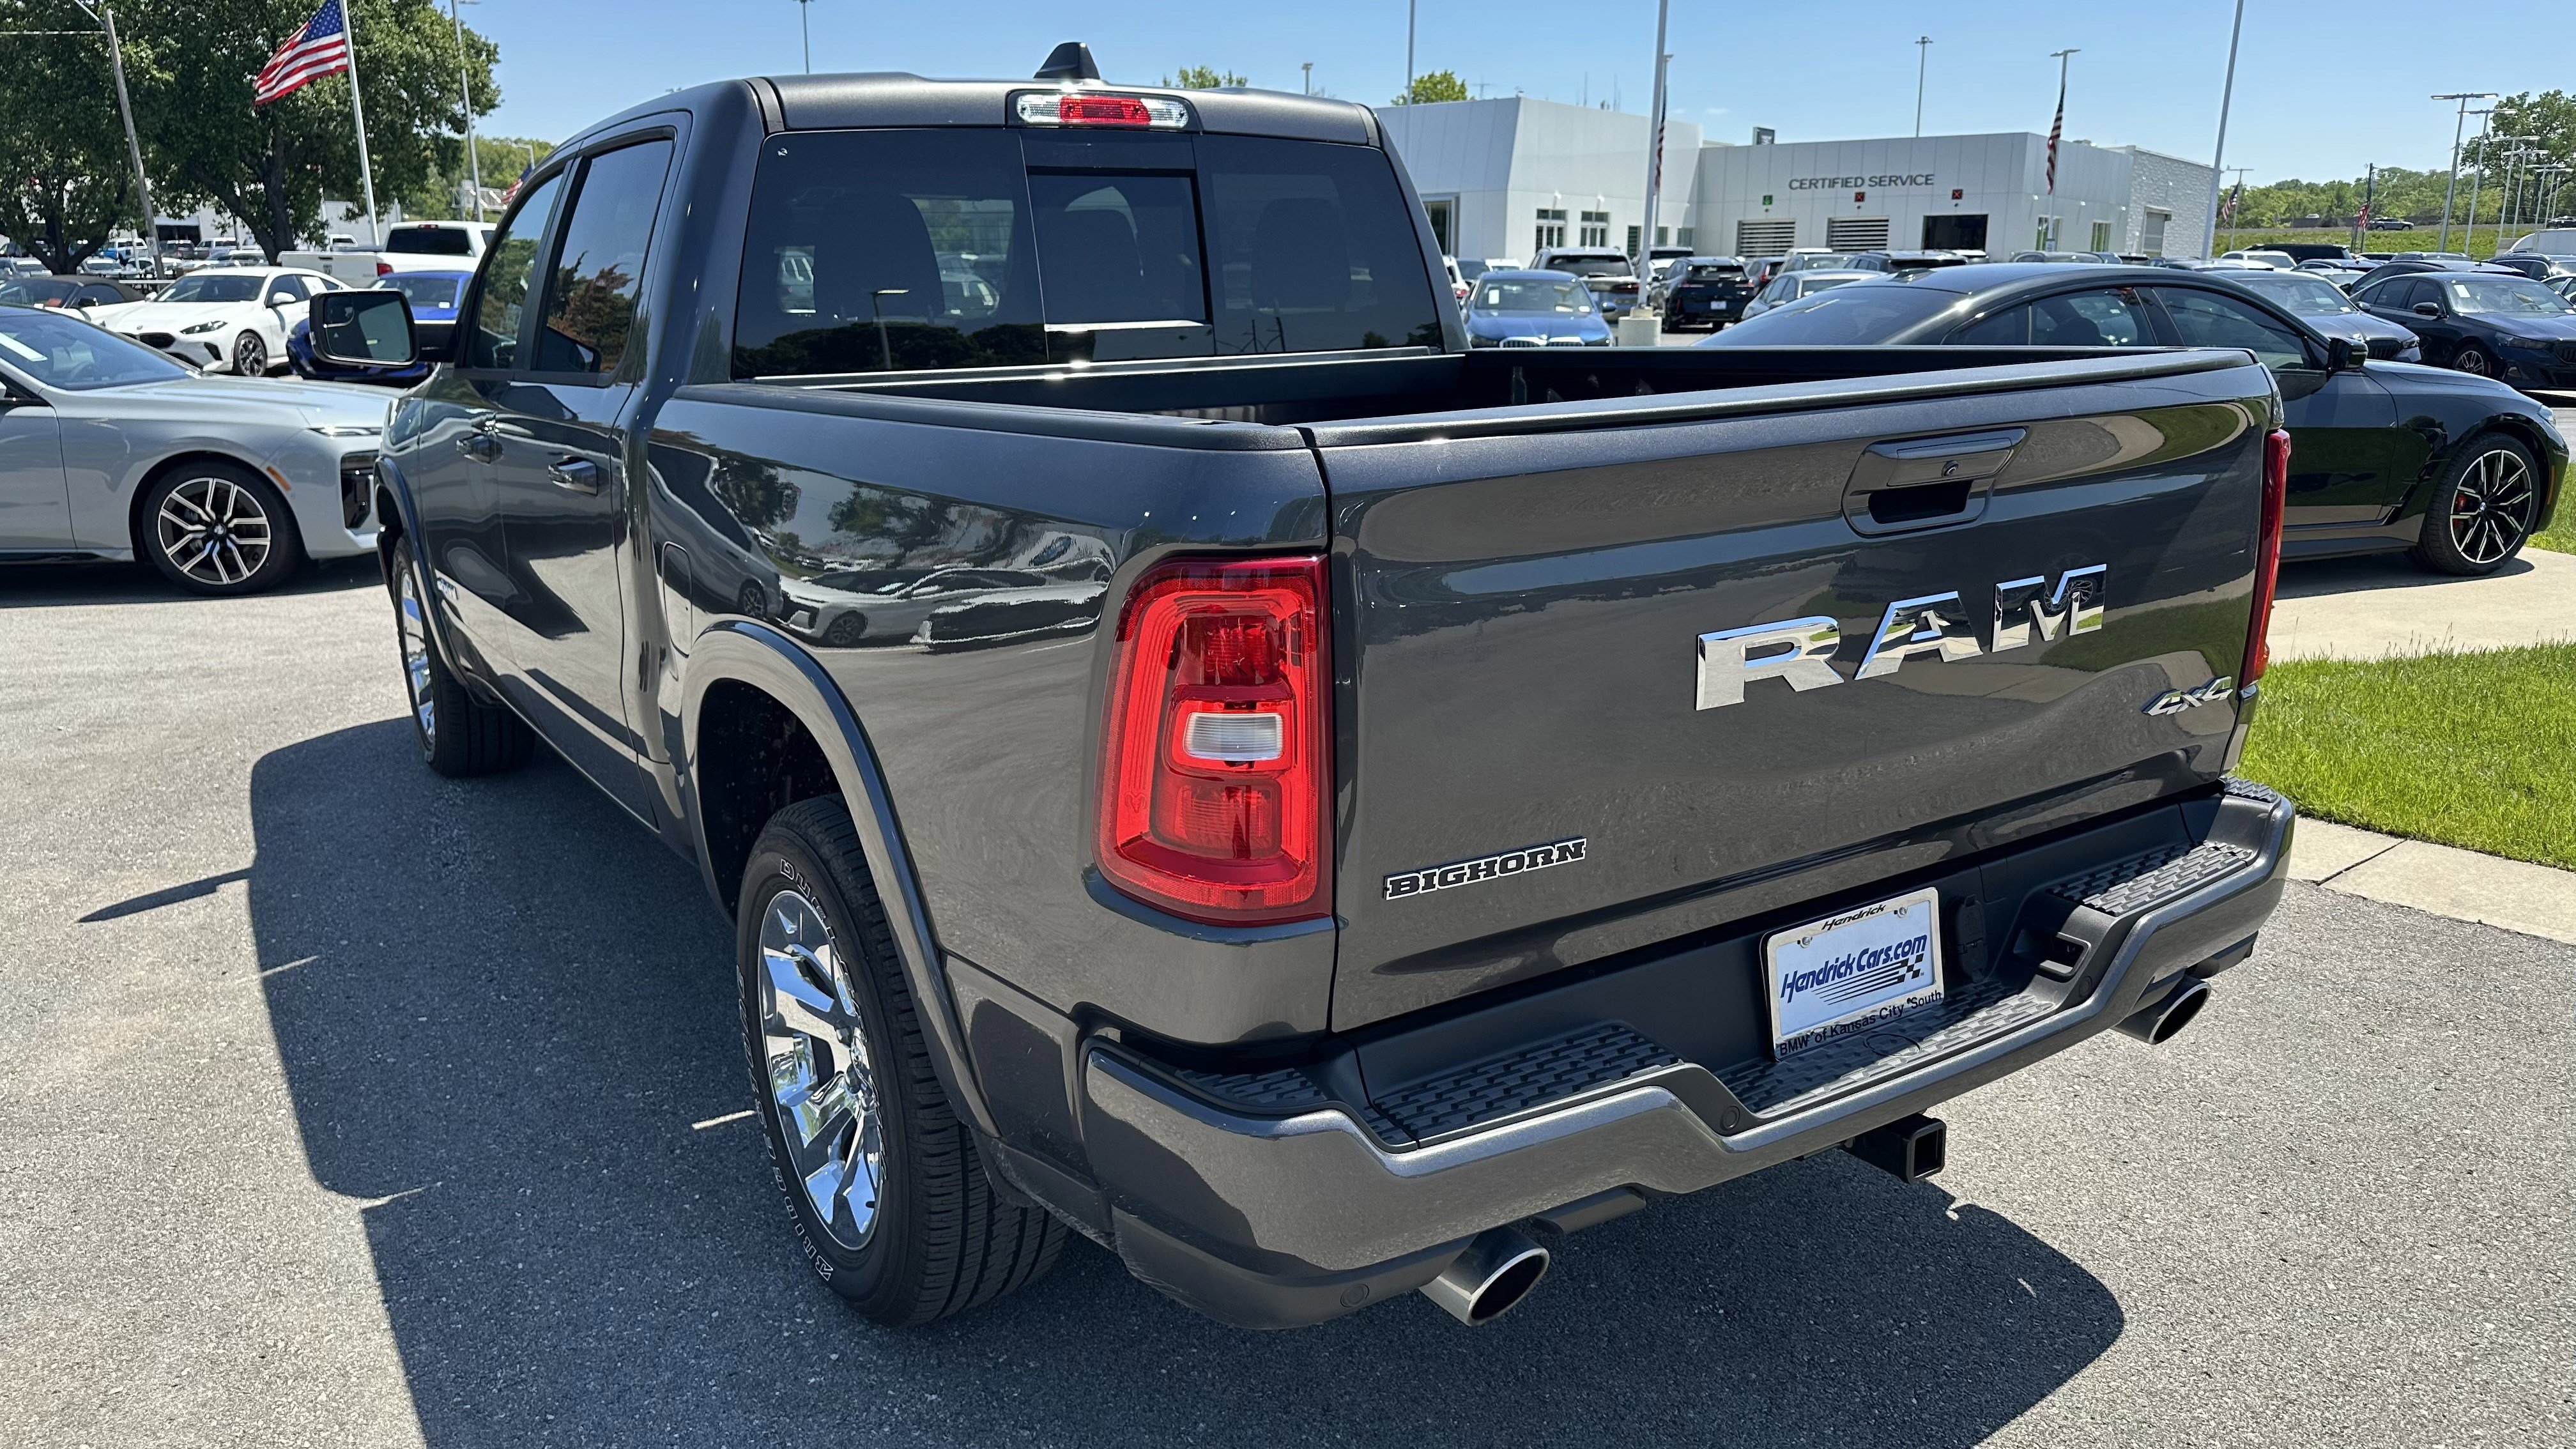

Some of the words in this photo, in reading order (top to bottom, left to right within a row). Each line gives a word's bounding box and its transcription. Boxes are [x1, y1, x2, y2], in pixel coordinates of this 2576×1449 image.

[1788, 176, 1865, 190] CERTIFIED
[1867, 173, 1935, 187] SERVICE
[1695, 563, 2107, 711] RAM
[1383, 836, 1588, 901] BIGHORN
[1821, 903, 1887, 931] Hendrick
[1779, 1033, 1809, 1057] BMW
[1814, 1027, 1827, 1044] of
[1830, 1012, 1876, 1039] Kansas
[1879, 1003, 1905, 1023] City
[1911, 990, 1942, 1010] South
[736, 964, 834, 1282] BRIDGESTONE
